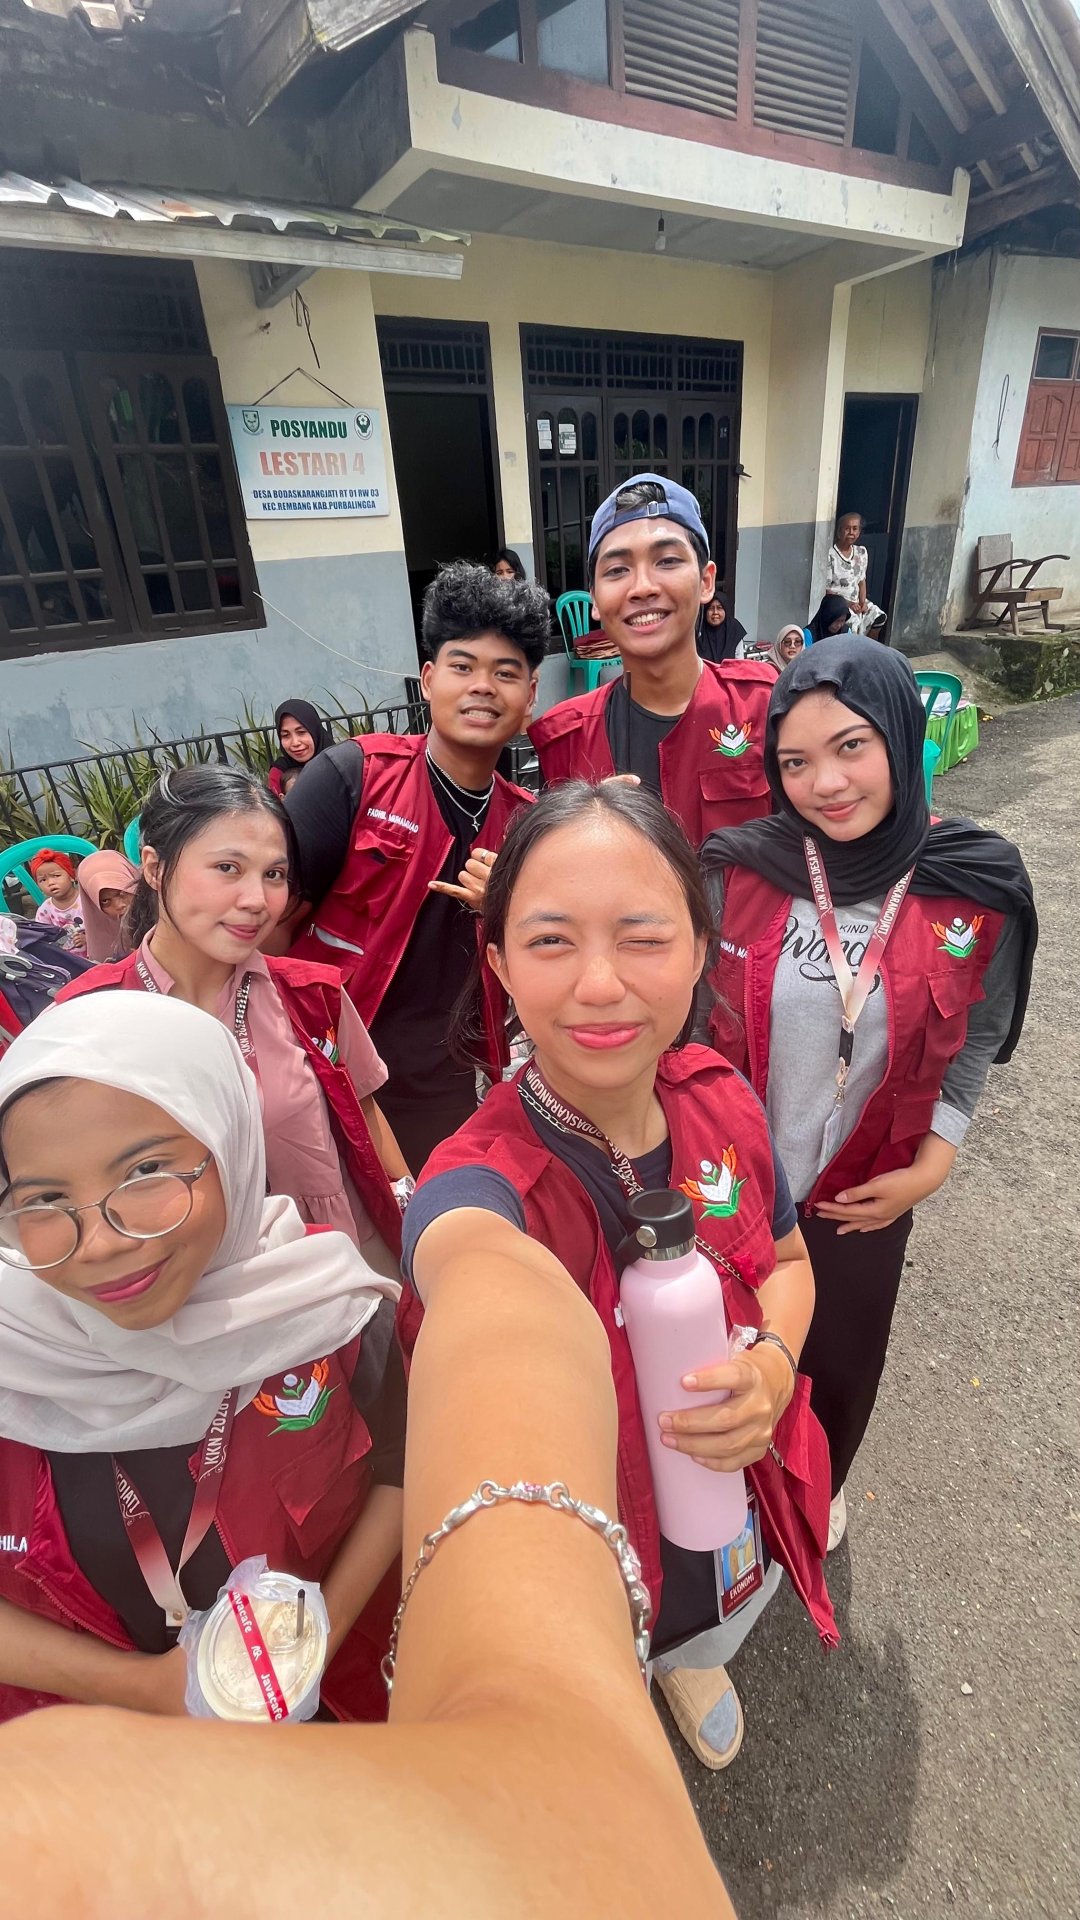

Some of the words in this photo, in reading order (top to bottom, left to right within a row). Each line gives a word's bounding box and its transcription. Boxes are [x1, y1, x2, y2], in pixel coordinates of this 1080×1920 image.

[270, 419, 348, 438] POSYANDU
[259, 451, 348, 476] LESTARI
[352, 452, 366, 476] 4
[253, 489, 272, 499] DESA
[339, 489, 348, 498] RT
[349, 489, 357, 498] 01
[358, 488, 369, 498] RW
[370, 488, 380, 498] 03
[808, 856, 820, 875] DESA
[813, 875, 825, 893] 2026
[817, 894, 828, 911] KKN
[136, 961, 149, 979] KKN
[240, 1037, 251, 1054] KKN
[204, 1437, 223, 1465] KKN
[729, 1571, 755, 1600] EKONOMI
[260, 1673, 283, 1720] Javacafe
